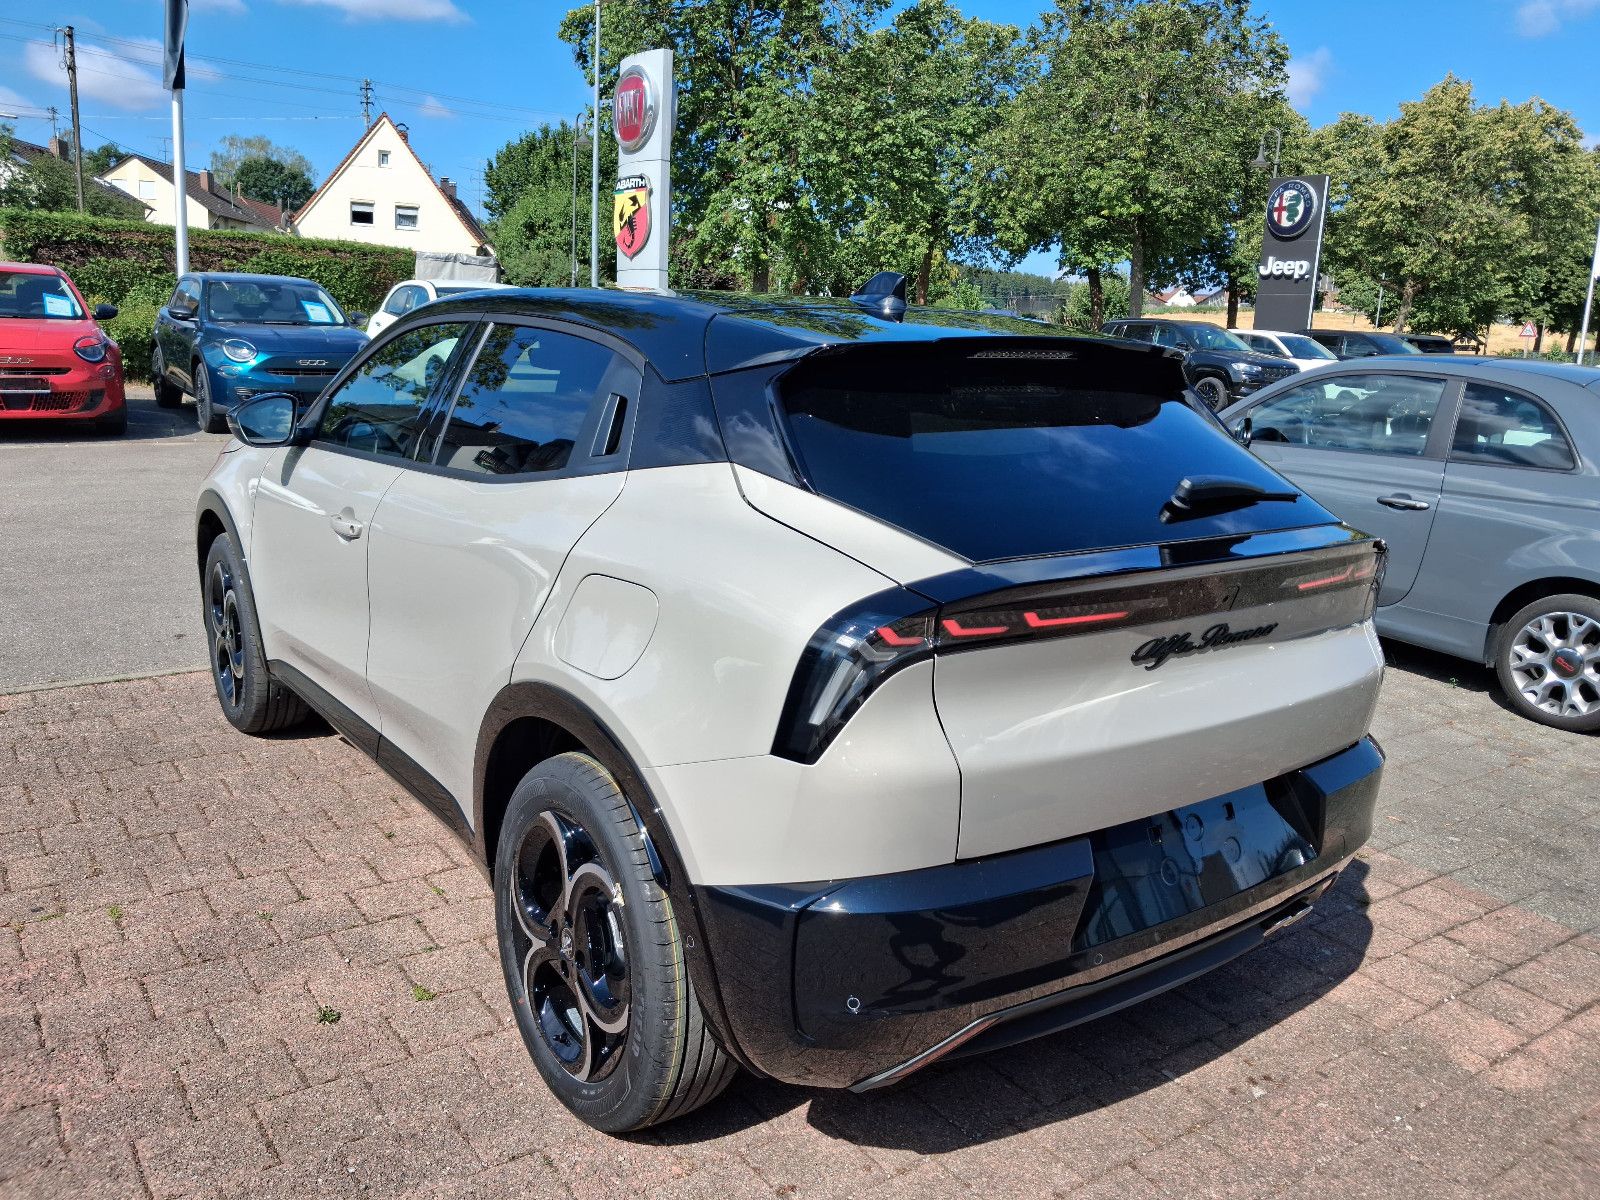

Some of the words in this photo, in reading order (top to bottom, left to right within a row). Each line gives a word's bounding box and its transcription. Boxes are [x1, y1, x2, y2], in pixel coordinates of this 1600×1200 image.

[618, 89, 641, 128] FIAT
[616, 177, 646, 190] ABARTH
[1269, 187, 1284, 210] ALFA
[1288, 183, 1311, 208] ROMEO
[1130, 631, 1196, 672] Alfa
[1200, 622, 1279, 651] Romeo
